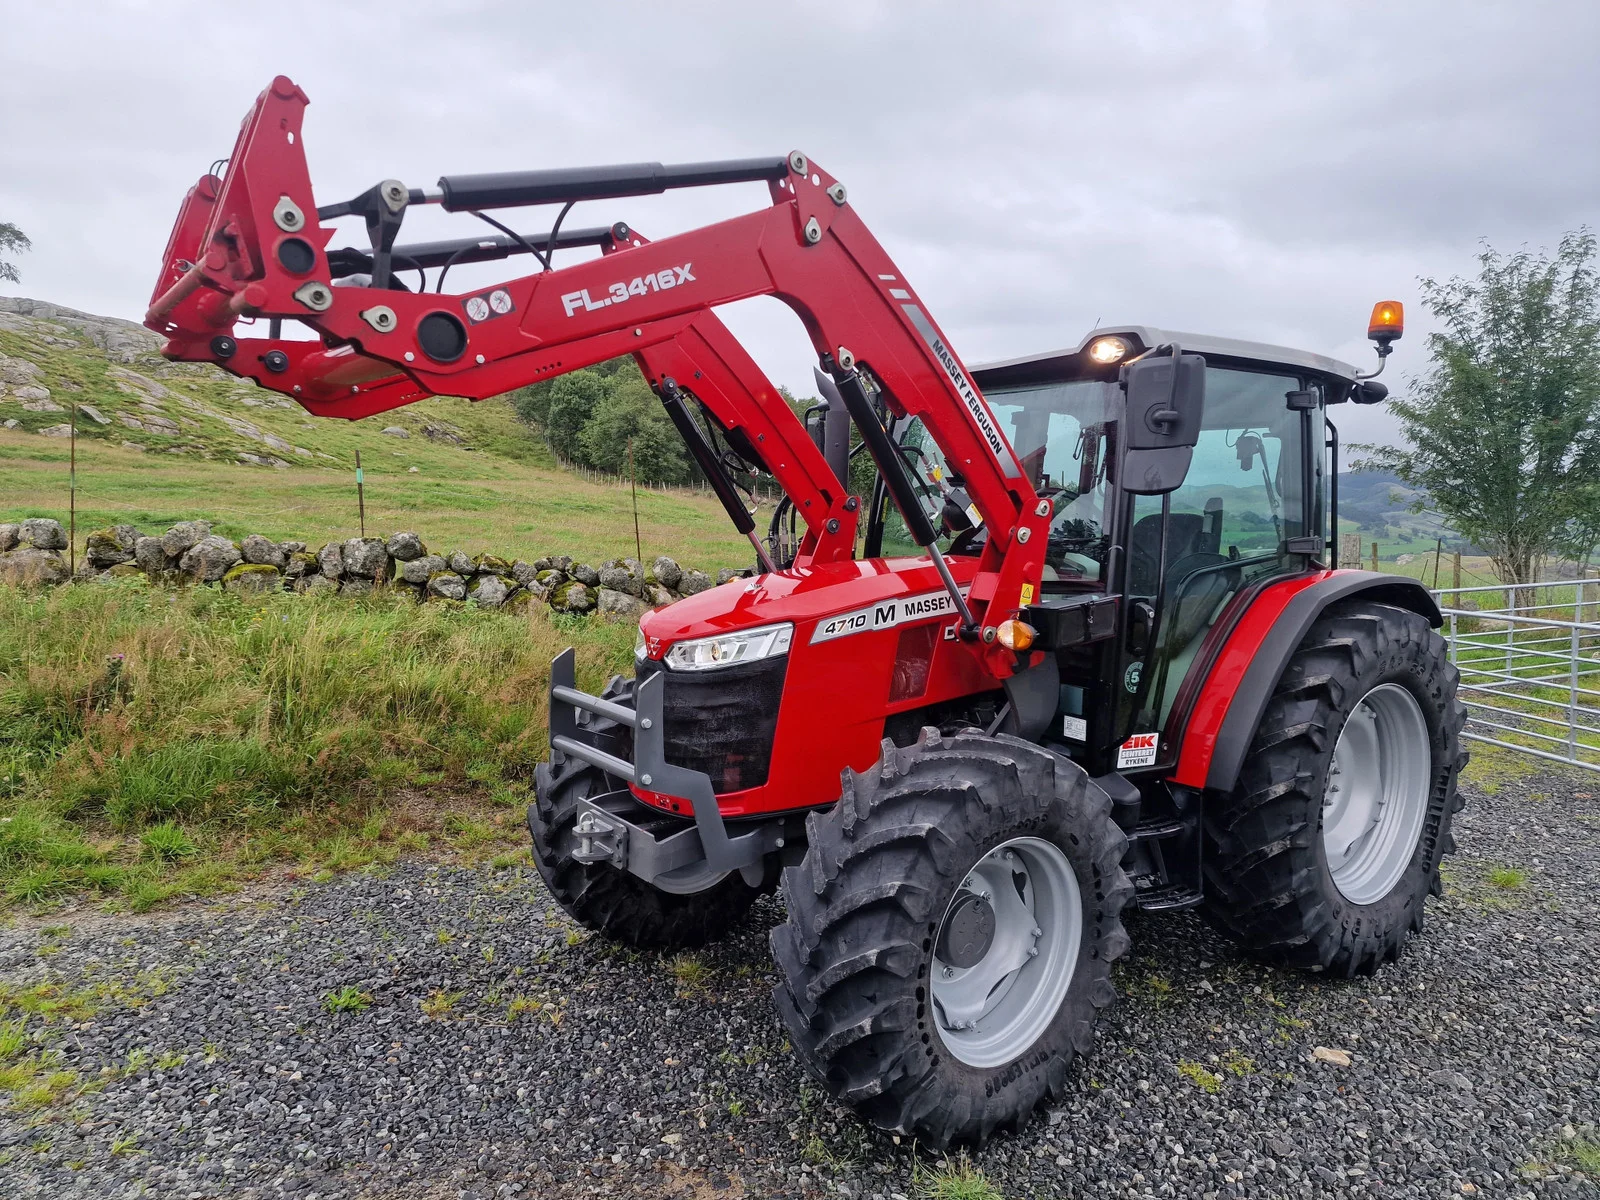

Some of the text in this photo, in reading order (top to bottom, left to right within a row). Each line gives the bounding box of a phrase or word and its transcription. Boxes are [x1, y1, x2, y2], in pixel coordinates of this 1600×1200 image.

[561, 263, 696, 317] FL.3416X
[932, 339, 1003, 455] MASSEY FERGUSON
[824, 595, 951, 635] 4710 M MASSEY
[1121, 749, 1154, 758] SENTERET
